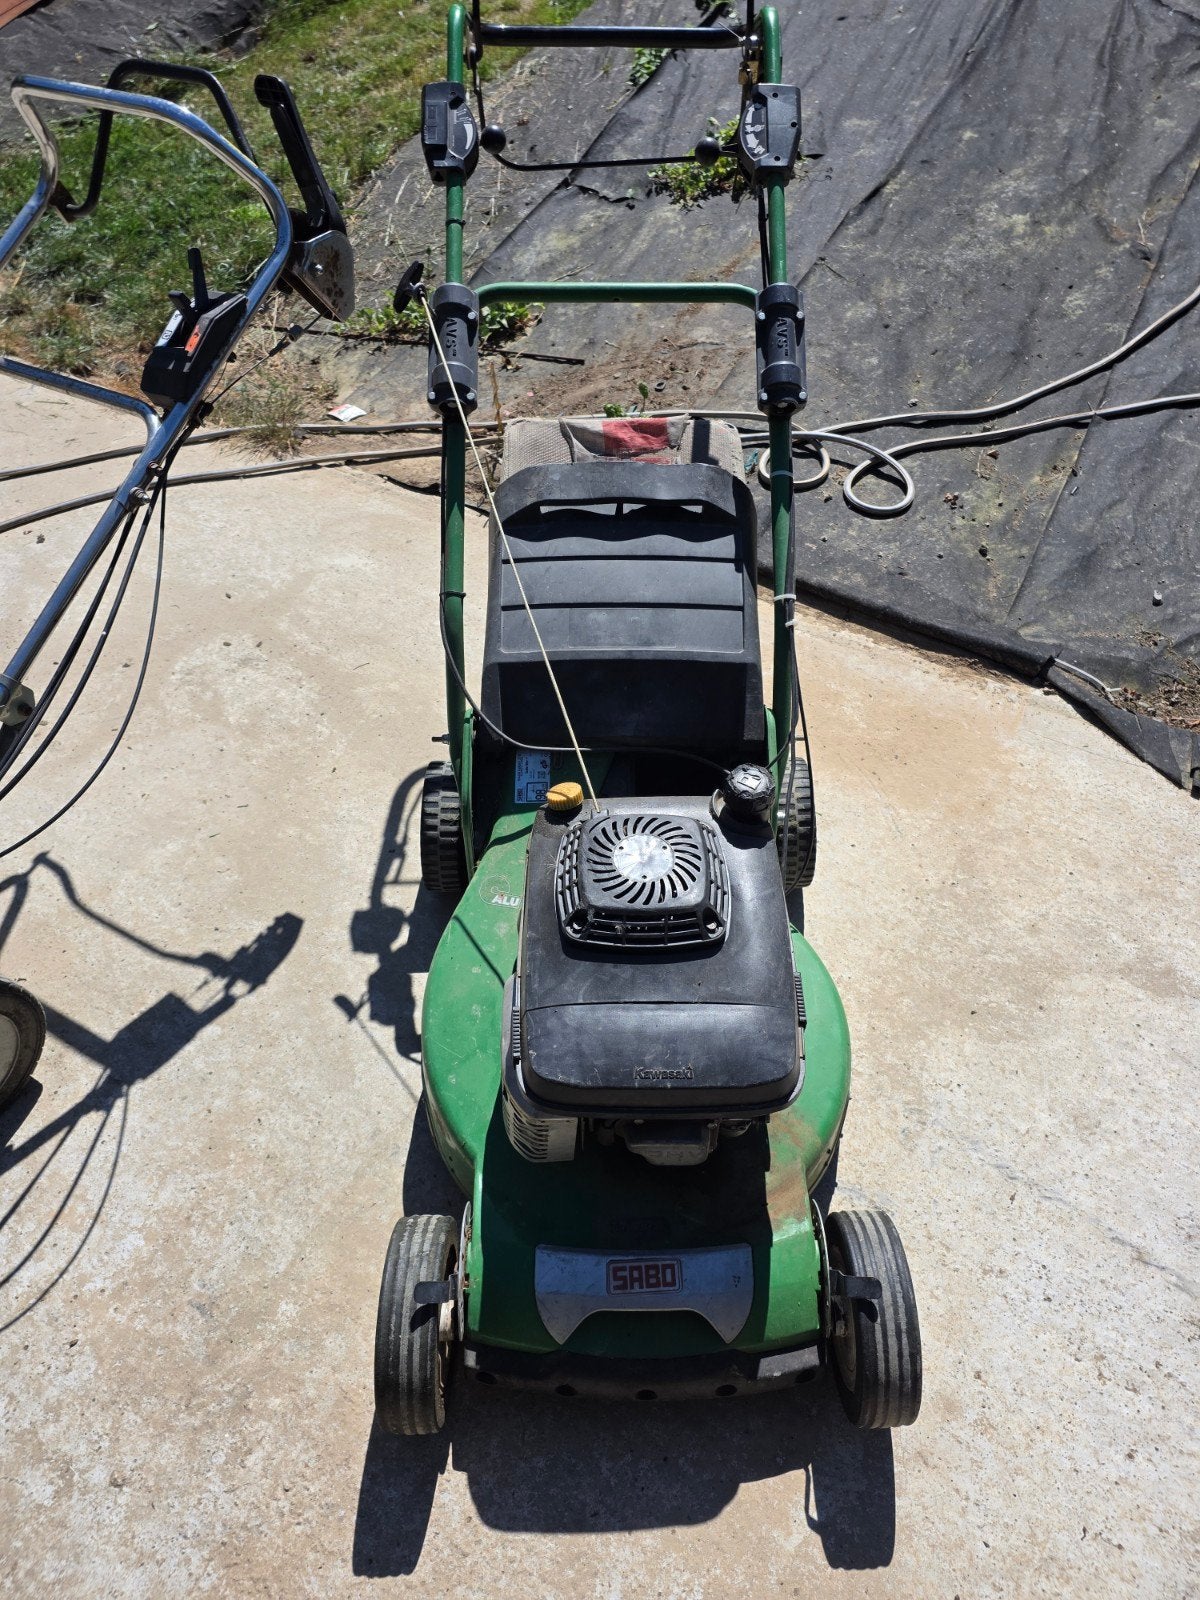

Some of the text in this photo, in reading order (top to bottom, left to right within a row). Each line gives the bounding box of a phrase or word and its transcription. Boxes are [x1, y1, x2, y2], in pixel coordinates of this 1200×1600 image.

[446, 317, 458, 349] AVS
[776, 317, 788, 349] AVS
[491, 894, 520, 906] ALU
[634, 1065, 695, 1080] Kawasaki
[612, 1262, 677, 1291] SABO
